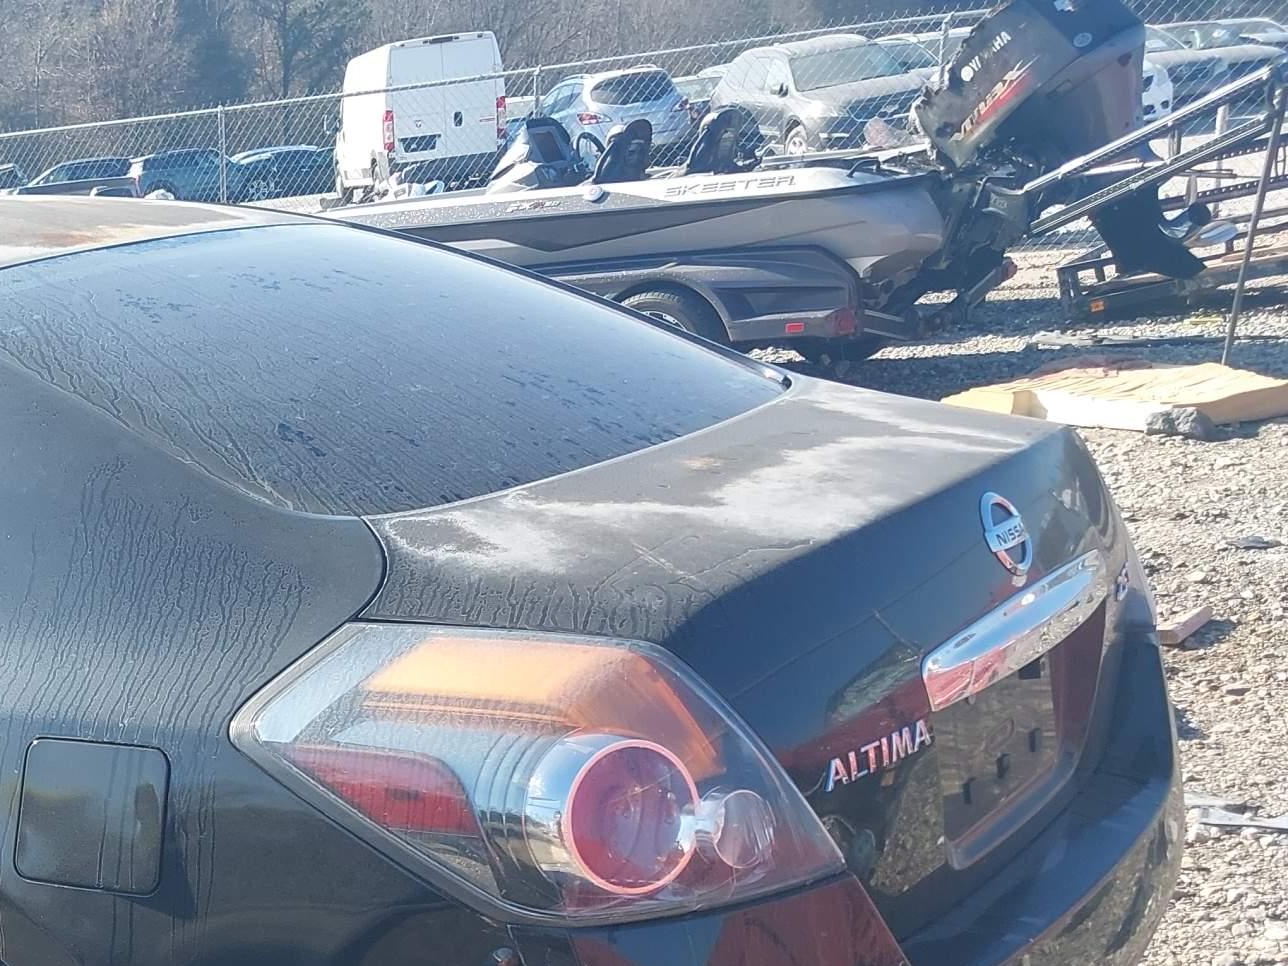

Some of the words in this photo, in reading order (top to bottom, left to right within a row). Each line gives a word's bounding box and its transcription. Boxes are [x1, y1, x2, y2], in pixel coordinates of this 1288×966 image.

[968, 31, 1012, 72] YHA
[664, 175, 796, 197] SKEETER
[824, 719, 932, 792] ALTIMA
